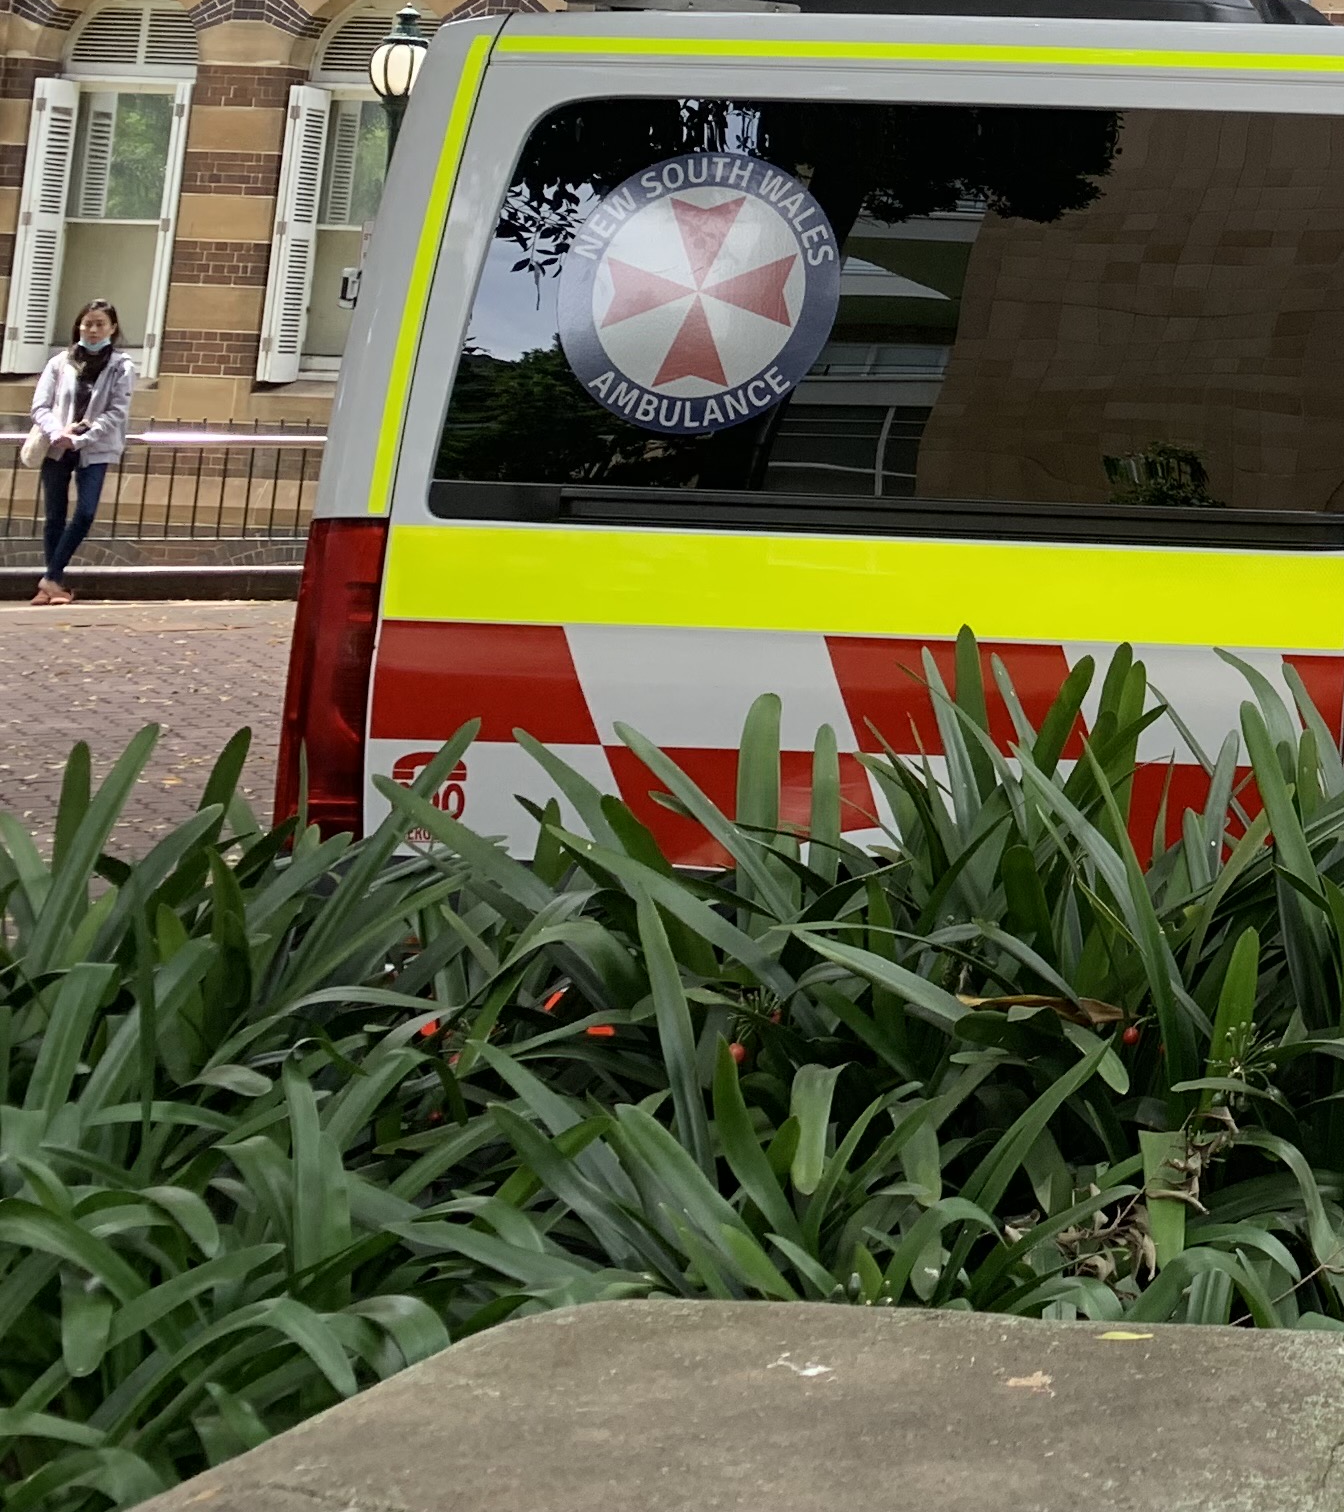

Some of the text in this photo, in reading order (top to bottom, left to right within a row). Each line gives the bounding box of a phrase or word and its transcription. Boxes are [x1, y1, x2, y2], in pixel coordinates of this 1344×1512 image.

[574, 156, 834, 267] NEW SOUTH WALES
[587, 365, 792, 428] AMBULANCE
